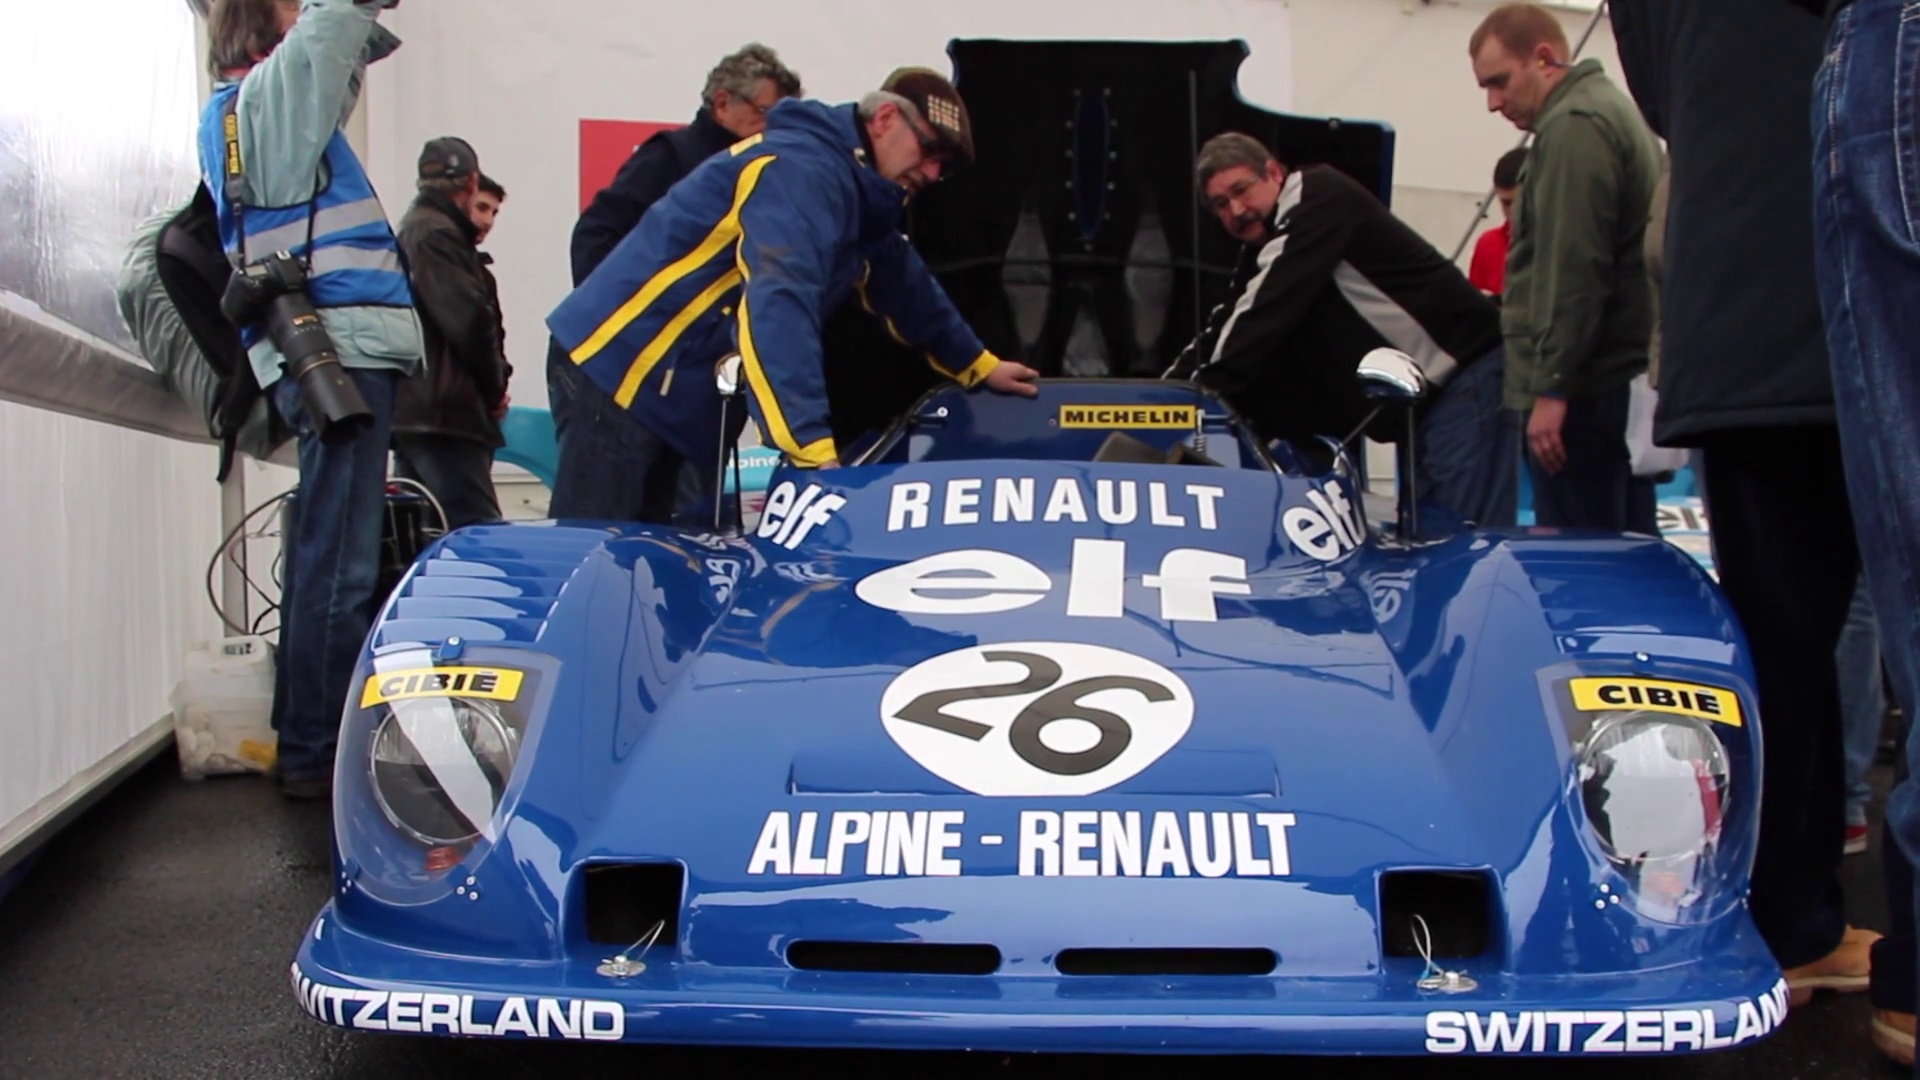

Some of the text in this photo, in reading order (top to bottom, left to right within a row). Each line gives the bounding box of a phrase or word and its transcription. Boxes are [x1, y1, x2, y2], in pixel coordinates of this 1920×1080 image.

[1065, 410, 1189, 424] MICHELIN
[757, 481, 848, 550] elf
[887, 477, 1225, 533] RENAULT
[1282, 479, 1367, 562] elf
[855, 537, 1252, 622] elf
[892, 650, 1176, 776] 26
[746, 810, 965, 876] ALPINE
[1018, 810, 1296, 877] RENAULT
